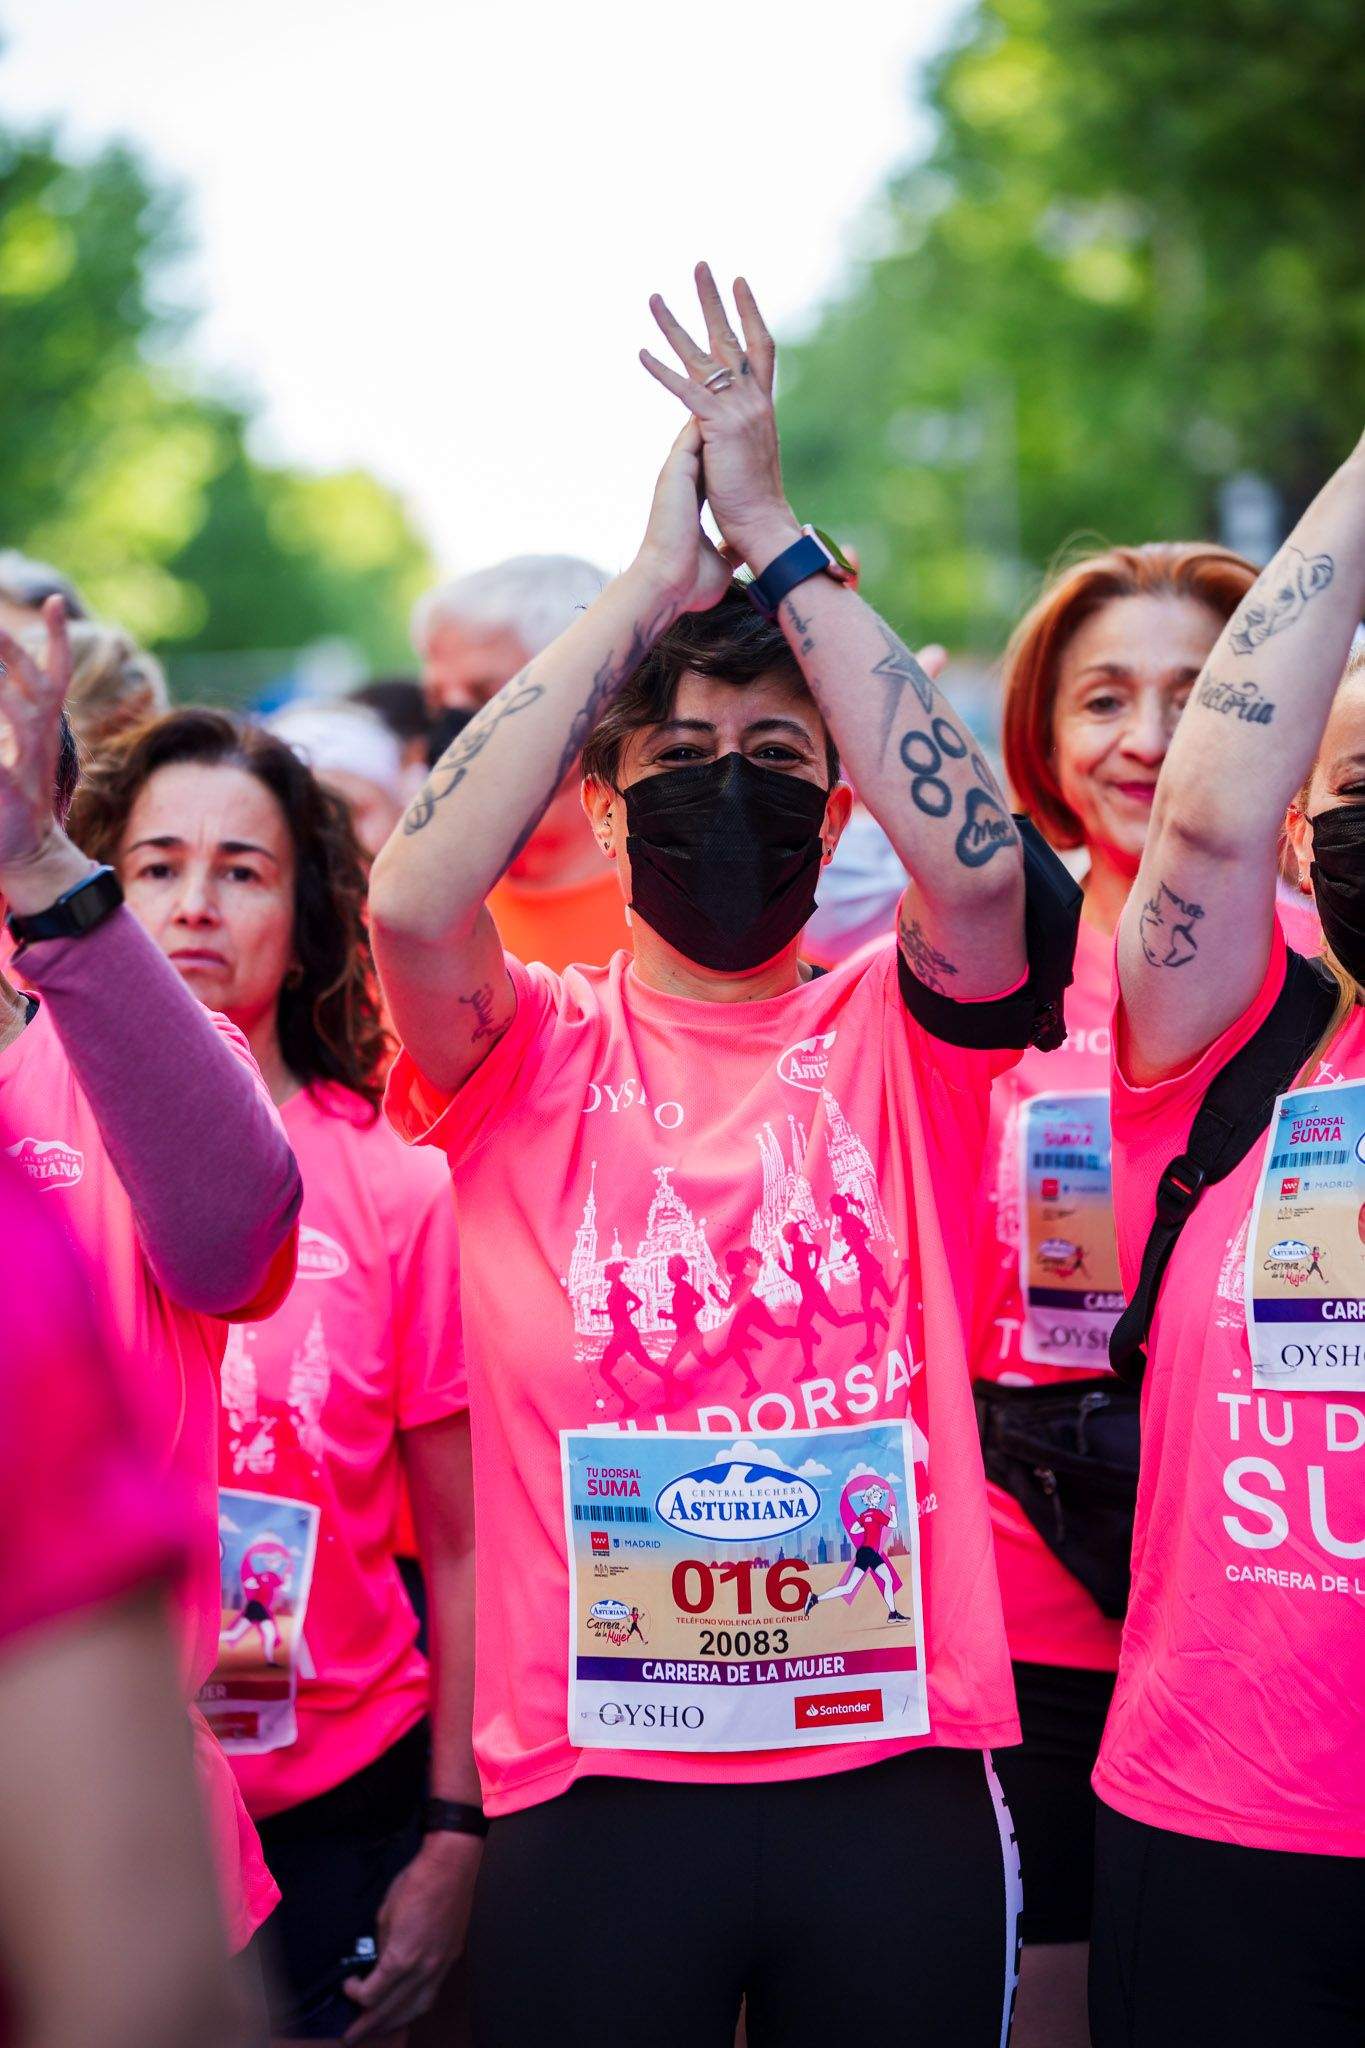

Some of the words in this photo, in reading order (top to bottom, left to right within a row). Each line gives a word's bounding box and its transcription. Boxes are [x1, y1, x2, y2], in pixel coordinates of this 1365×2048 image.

[1292, 1120, 1303, 1130] TU
[1306, 1117, 1345, 1127] DORSAL
[1290, 1127, 1342, 1145] SUMA
[1315, 1181, 1353, 1189] MADRID
[1217, 1392, 1294, 1446] TU
[586, 1467, 599, 1478] TU
[601, 1468, 642, 1479] DORSAL
[587, 1479, 641, 1497] SUMA
[692, 1489, 744, 1497] CENTRAL
[749, 1486, 803, 1497] LECHERA
[624, 1540, 661, 1549] MADRID
[671, 1558, 812, 1615] 016
[1225, 1565, 1316, 1590] CARRERA
[1321, 1575, 1348, 1592] DE
[586, 1617, 620, 1631] Carrera
[675, 1616, 717, 1626] TELÉFONO
[718, 1617, 761, 1626] VIOLENCIA
[763, 1616, 774, 1625] DE
[776, 1614, 810, 1624] GÉNERO
[606, 1630, 631, 1647] Mujer
[699, 1629, 789, 1657] 20083
[642, 1662, 722, 1683] CARRERA
[727, 1665, 750, 1684] DE
[756, 1663, 779, 1682] LA
[785, 1656, 845, 1679] MUJER
[599, 1702, 705, 1730] OYSHO
[819, 1703, 871, 1716] Santander
